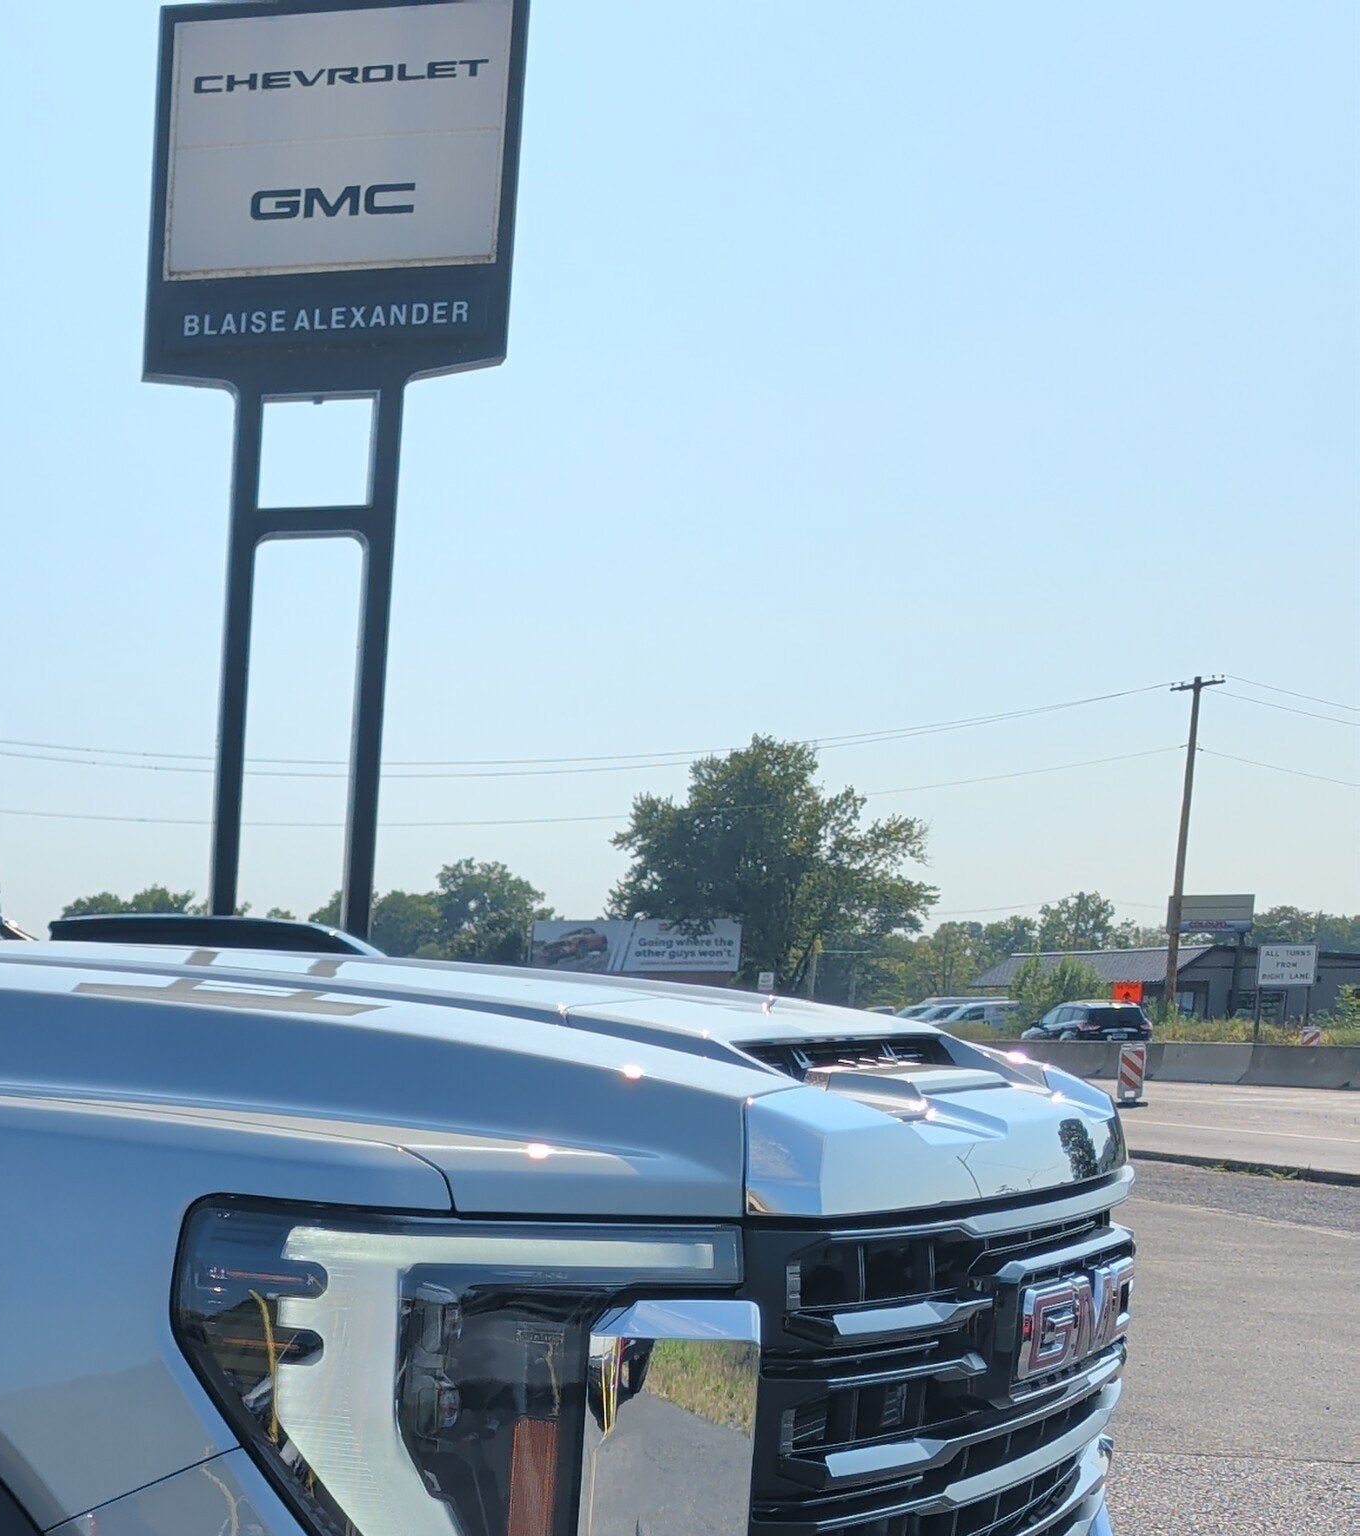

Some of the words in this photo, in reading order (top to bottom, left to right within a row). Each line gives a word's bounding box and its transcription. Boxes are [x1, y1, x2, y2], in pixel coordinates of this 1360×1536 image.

[193, 58, 490, 95] CHEVROLET
[250, 182, 416, 221] GMC
[183, 310, 287, 338] BLAISE
[293, 300, 470, 332] ALEXANDER
[634, 949, 666, 958] other
[668, 950, 696, 960] guys
[638, 938, 674, 949] Going
[714, 938, 735, 947] the
[1289, 972, 1311, 980] LANE
[1016, 1256, 1135, 1380] GMC
